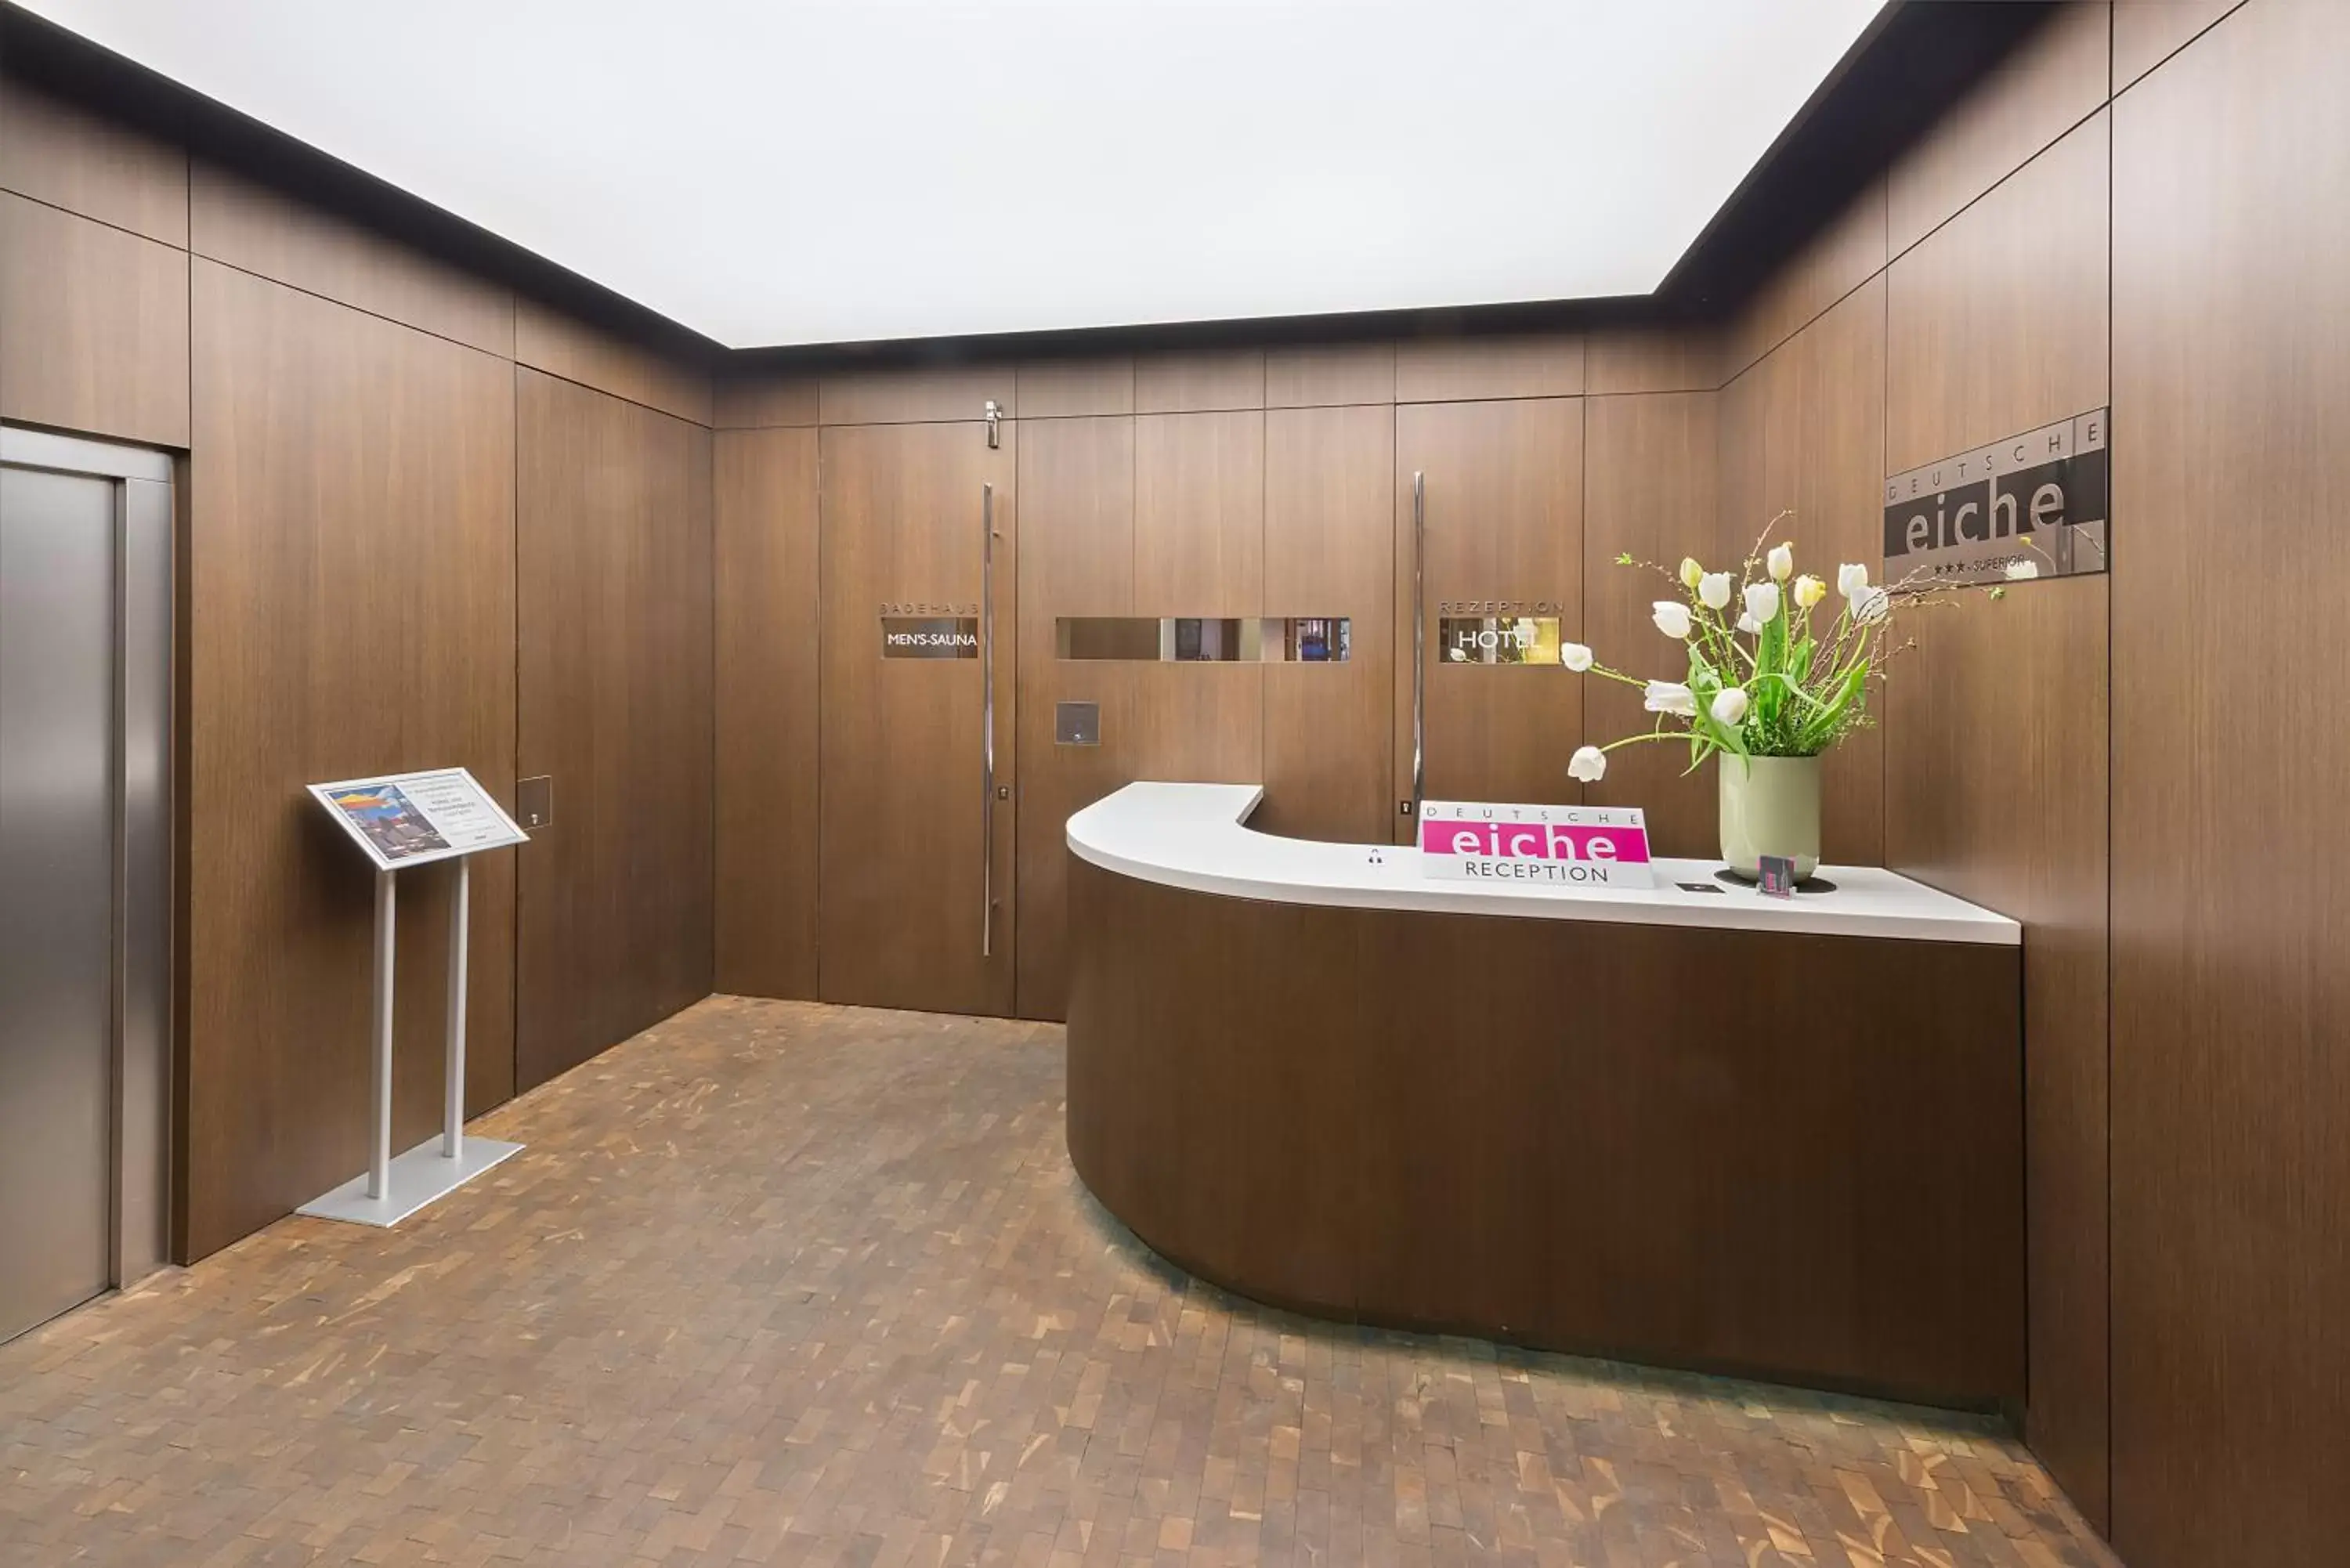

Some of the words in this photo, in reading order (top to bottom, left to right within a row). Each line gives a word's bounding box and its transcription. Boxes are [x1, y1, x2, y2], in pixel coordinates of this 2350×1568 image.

[1889, 423, 2098, 499] DEUTSCHE
[1906, 475, 2065, 555] eiche
[1973, 554, 2025, 573] SUPERIOR
[1440, 601, 1565, 614] REZEPTION
[888, 634, 978, 646] MEN'S-SAUNA
[1459, 630, 1541, 649] HOTEL
[1426, 807, 1637, 824] DEUTSCHE
[1452, 823, 1618, 862] eiche
[1466, 861, 1607, 882] RECEPTION
